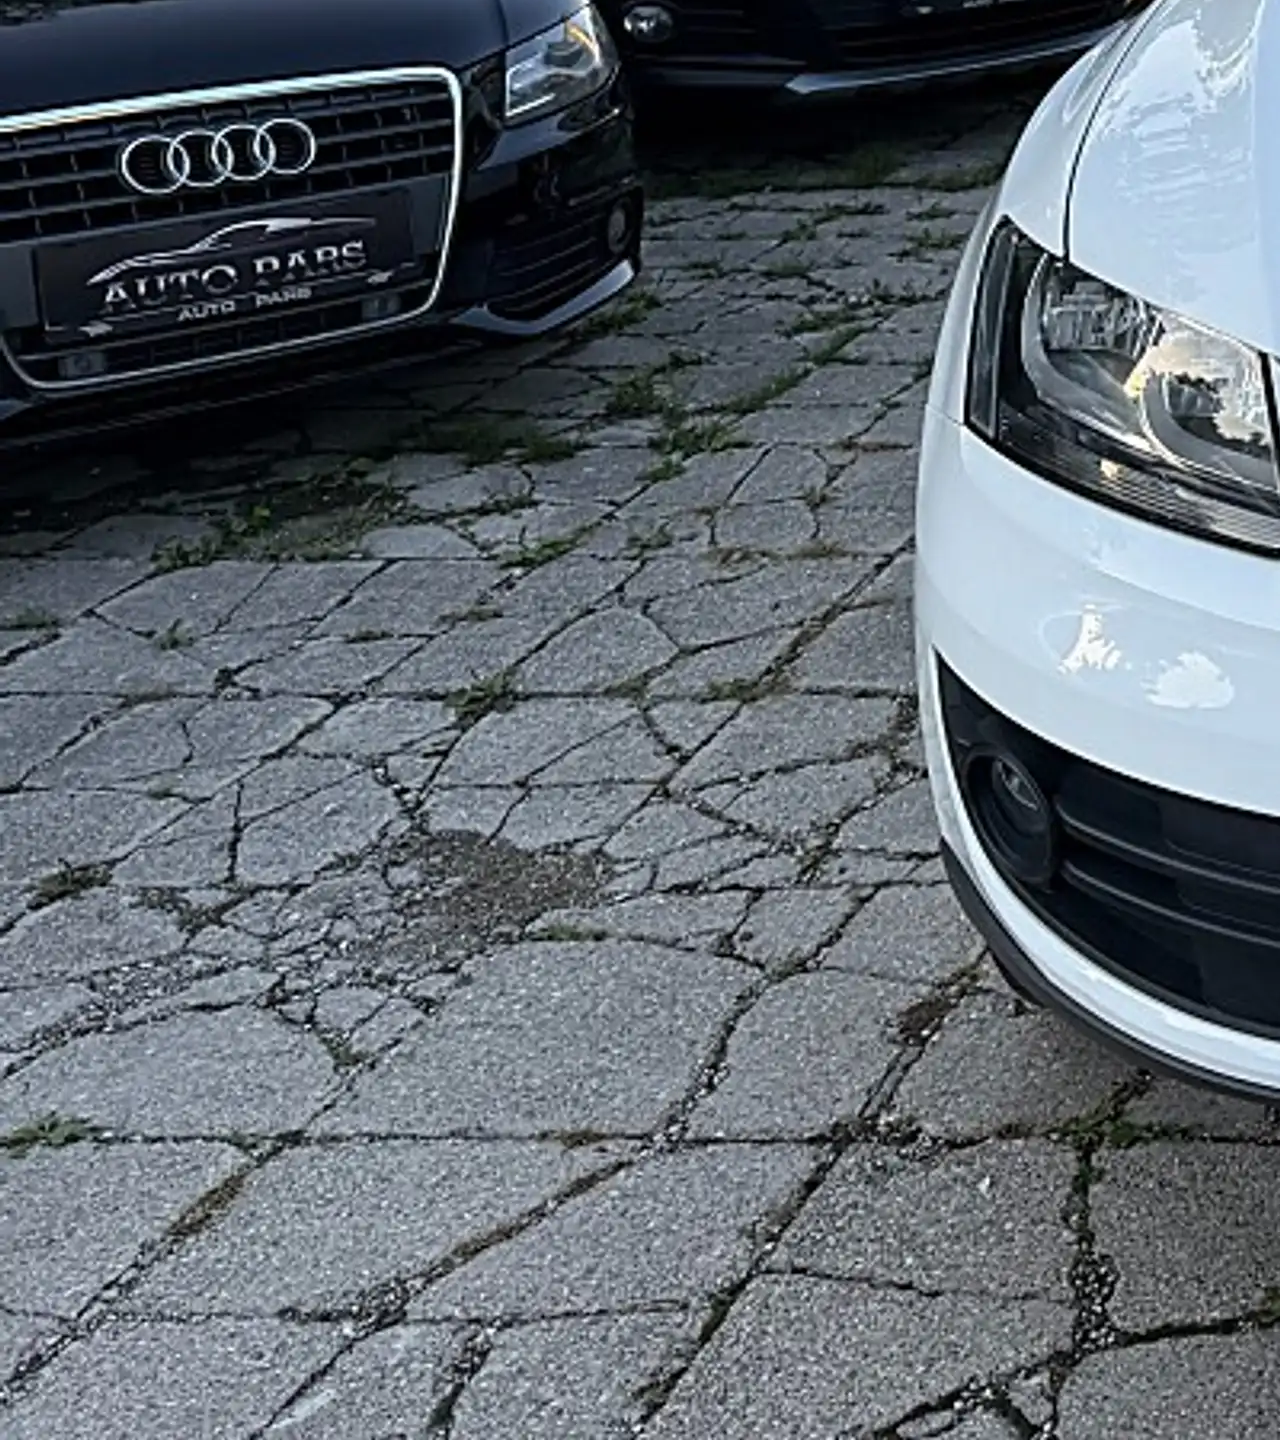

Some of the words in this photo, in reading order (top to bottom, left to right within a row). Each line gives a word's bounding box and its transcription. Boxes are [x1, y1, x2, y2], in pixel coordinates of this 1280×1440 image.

[104, 264, 238, 313] AUTO
[253, 240, 367, 287] PARS
[177, 301, 236, 323] AUTO
[254, 285, 312, 309] PARS
